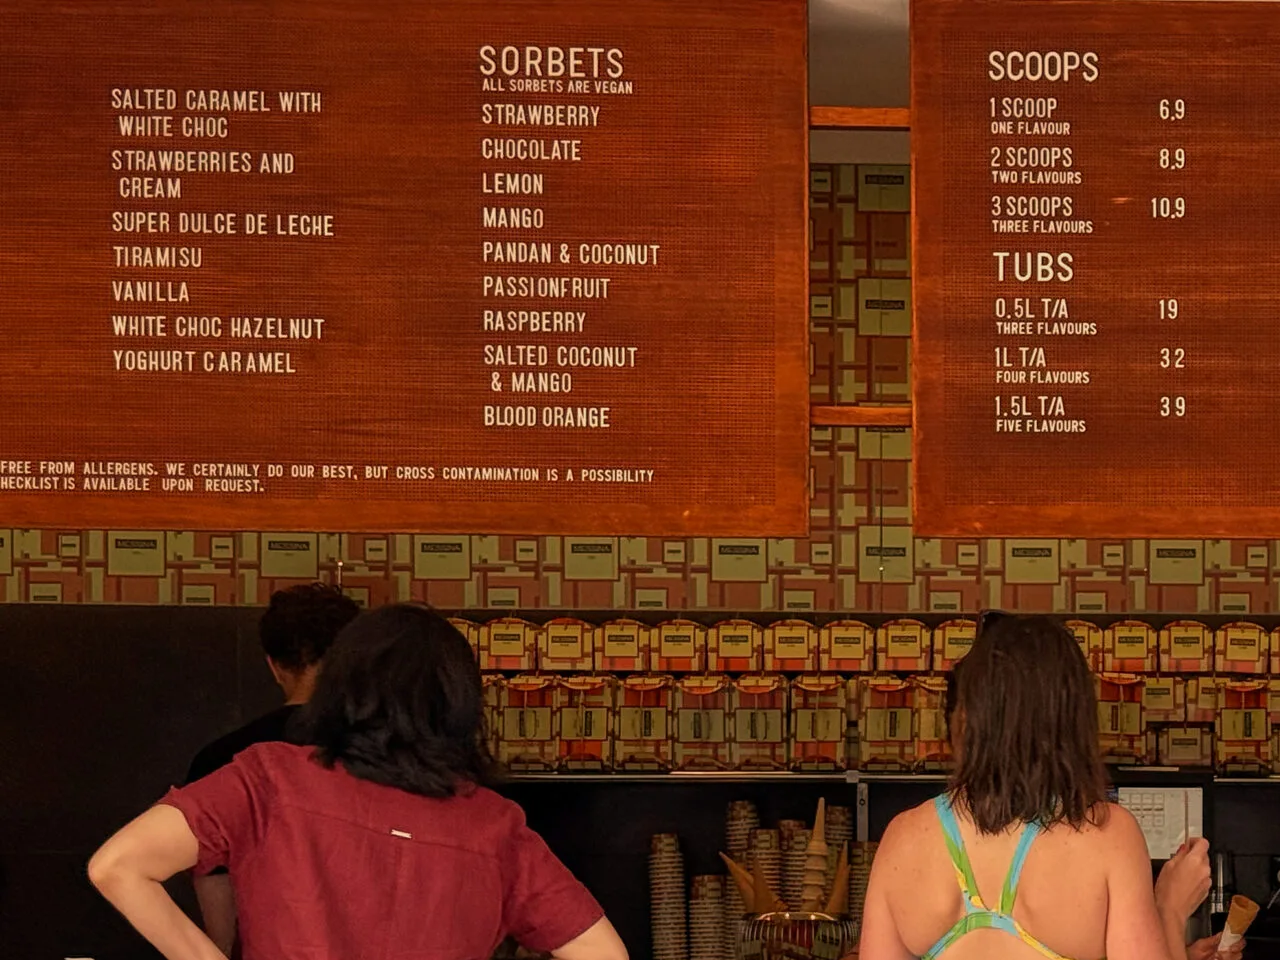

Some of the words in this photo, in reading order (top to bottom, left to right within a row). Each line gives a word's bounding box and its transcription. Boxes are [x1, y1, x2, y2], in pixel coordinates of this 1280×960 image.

[479, 45, 623, 79] SORBETS
[988, 50, 1099, 82] SCOOPS
[482, 77, 506, 92] ALL
[509, 78, 564, 93] SORBETS
[567, 80, 590, 94] ARE
[594, 80, 633, 94] VEGAN
[111, 88, 177, 110] SALTED
[186, 89, 271, 112] CARAMEL
[279, 91, 321, 113] WITH
[989, 97, 996, 118] 1
[1002, 97, 1057, 119] SCOOP
[1159, 98, 1185, 121] 6.9
[482, 103, 600, 127] STRAWBERRY
[118, 115, 173, 137] WHITE
[182, 116, 228, 138] CHOC
[991, 121, 1014, 135] ONE
[1017, 121, 1071, 136] FLAVOUR
[482, 138, 581, 161] CHOCOLATE
[990, 146, 1001, 167] 2
[1006, 146, 1073, 168] SCOOPS
[1159, 148, 1185, 169] 8.9
[111, 149, 252, 173] STRAWBERRIES
[259, 152, 294, 174] AND
[119, 177, 181, 199] CREAM
[482, 172, 543, 194] LEMON
[991, 170, 1018, 184] TWO
[1021, 170, 1082, 185] FLAVOURS
[991, 195, 1002, 216] 3
[1006, 196, 1073, 217] SCOOPS
[1151, 197, 1185, 219] 10.9
[112, 211, 170, 233] SUPER
[179, 212, 237, 234] DULCE
[245, 213, 268, 235] DE
[277, 214, 334, 236] LECHE
[483, 207, 544, 229] MANGO
[991, 219, 1029, 233] THREE
[1033, 219, 1093, 234] FLAVOURS
[112, 246, 202, 268] TIRAMISU
[483, 241, 551, 264] PANDAN
[559, 243, 571, 264] &
[579, 243, 660, 265] COCONUT
[992, 251, 1074, 282] TUBS
[112, 280, 190, 302] VANILLA
[483, 275, 611, 299] PASSIONFRUIT
[995, 297, 1035, 319] 0.5L
[1040, 298, 1069, 319] T/A
[1159, 299, 1178, 320] 19
[112, 315, 167, 337] WHITE
[175, 316, 222, 338] CHOC
[231, 317, 325, 340] HAZELNUT
[483, 310, 586, 333] RASPBERRY
[996, 321, 1033, 335] THREE
[1037, 321, 1097, 335] FLAVOURS
[113, 349, 197, 372] YOGHURT
[203, 351, 296, 373] CARAMEL
[484, 344, 548, 366] SALTED
[557, 345, 638, 368] COCONUT
[994, 347, 1013, 368] 1L
[1018, 347, 1047, 368] T/A
[1160, 347, 1185, 369] 32
[491, 371, 502, 392] &
[511, 372, 572, 393] MANGO
[996, 370, 1027, 384] FOUR
[1029, 370, 1090, 384] FLAVOURS
[484, 405, 537, 427] BLOOD
[542, 406, 610, 428] ORANGE
[995, 395, 1032, 417] 1.5L
[1037, 395, 1065, 416] T/A
[1160, 396, 1186, 417] 39
[996, 419, 1023, 432] FIVE
[1026, 419, 1086, 433] FLAVOURS
[0, 460, 32, 475] FREE
[39, 461, 75, 475] FROM
[83, 461, 159, 476] ALLERGENS.
[165, 462, 186, 476] WE
[193, 463, 260, 477] CERTAINLY
[267, 464, 284, 478] DO
[291, 464, 315, 478] OUR
[365, 465, 389, 479] BUT
[396, 466, 435, 480] CROSS
[442, 467, 539, 481] CONTAMINATION
[546, 468, 559, 481] IS
[566, 468, 574, 481] A
[581, 468, 654, 481] POSSIBILITY
[63, 476, 76, 490] IS
[83, 477, 150, 491] AVAILABLE
[162, 478, 194, 492] UPON
[205, 478, 265, 493] REQUEST.
